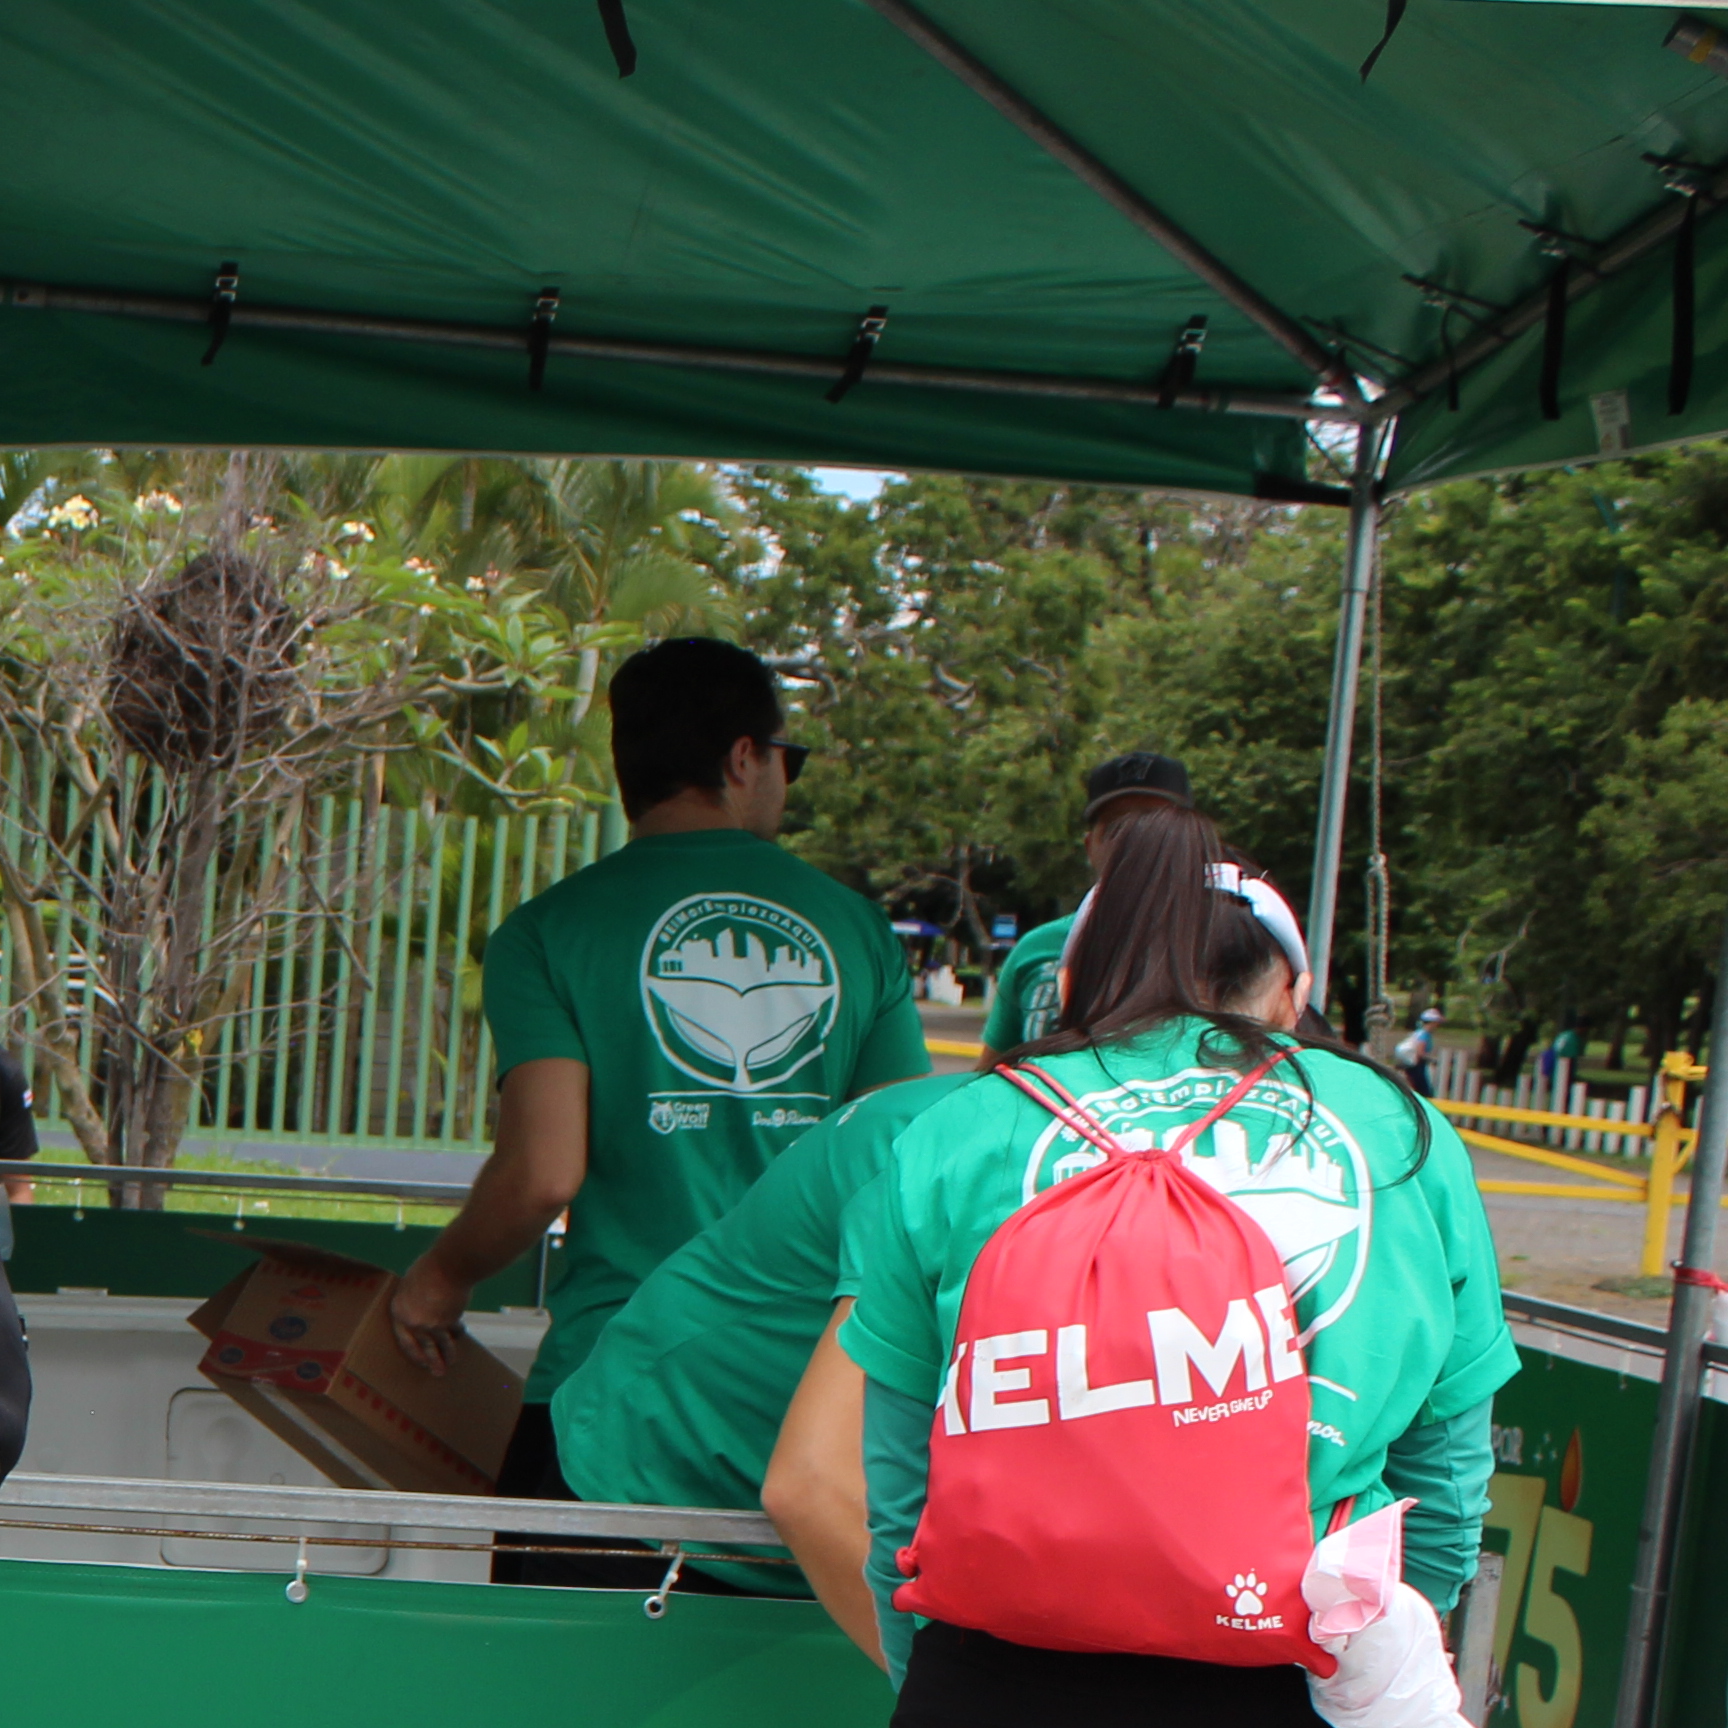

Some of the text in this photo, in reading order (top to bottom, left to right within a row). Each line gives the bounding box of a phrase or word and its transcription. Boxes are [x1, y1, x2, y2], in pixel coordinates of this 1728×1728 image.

[1172, 1389, 1275, 1428] NEVER GIVE UP
[1216, 1614, 1284, 1631] KELME
